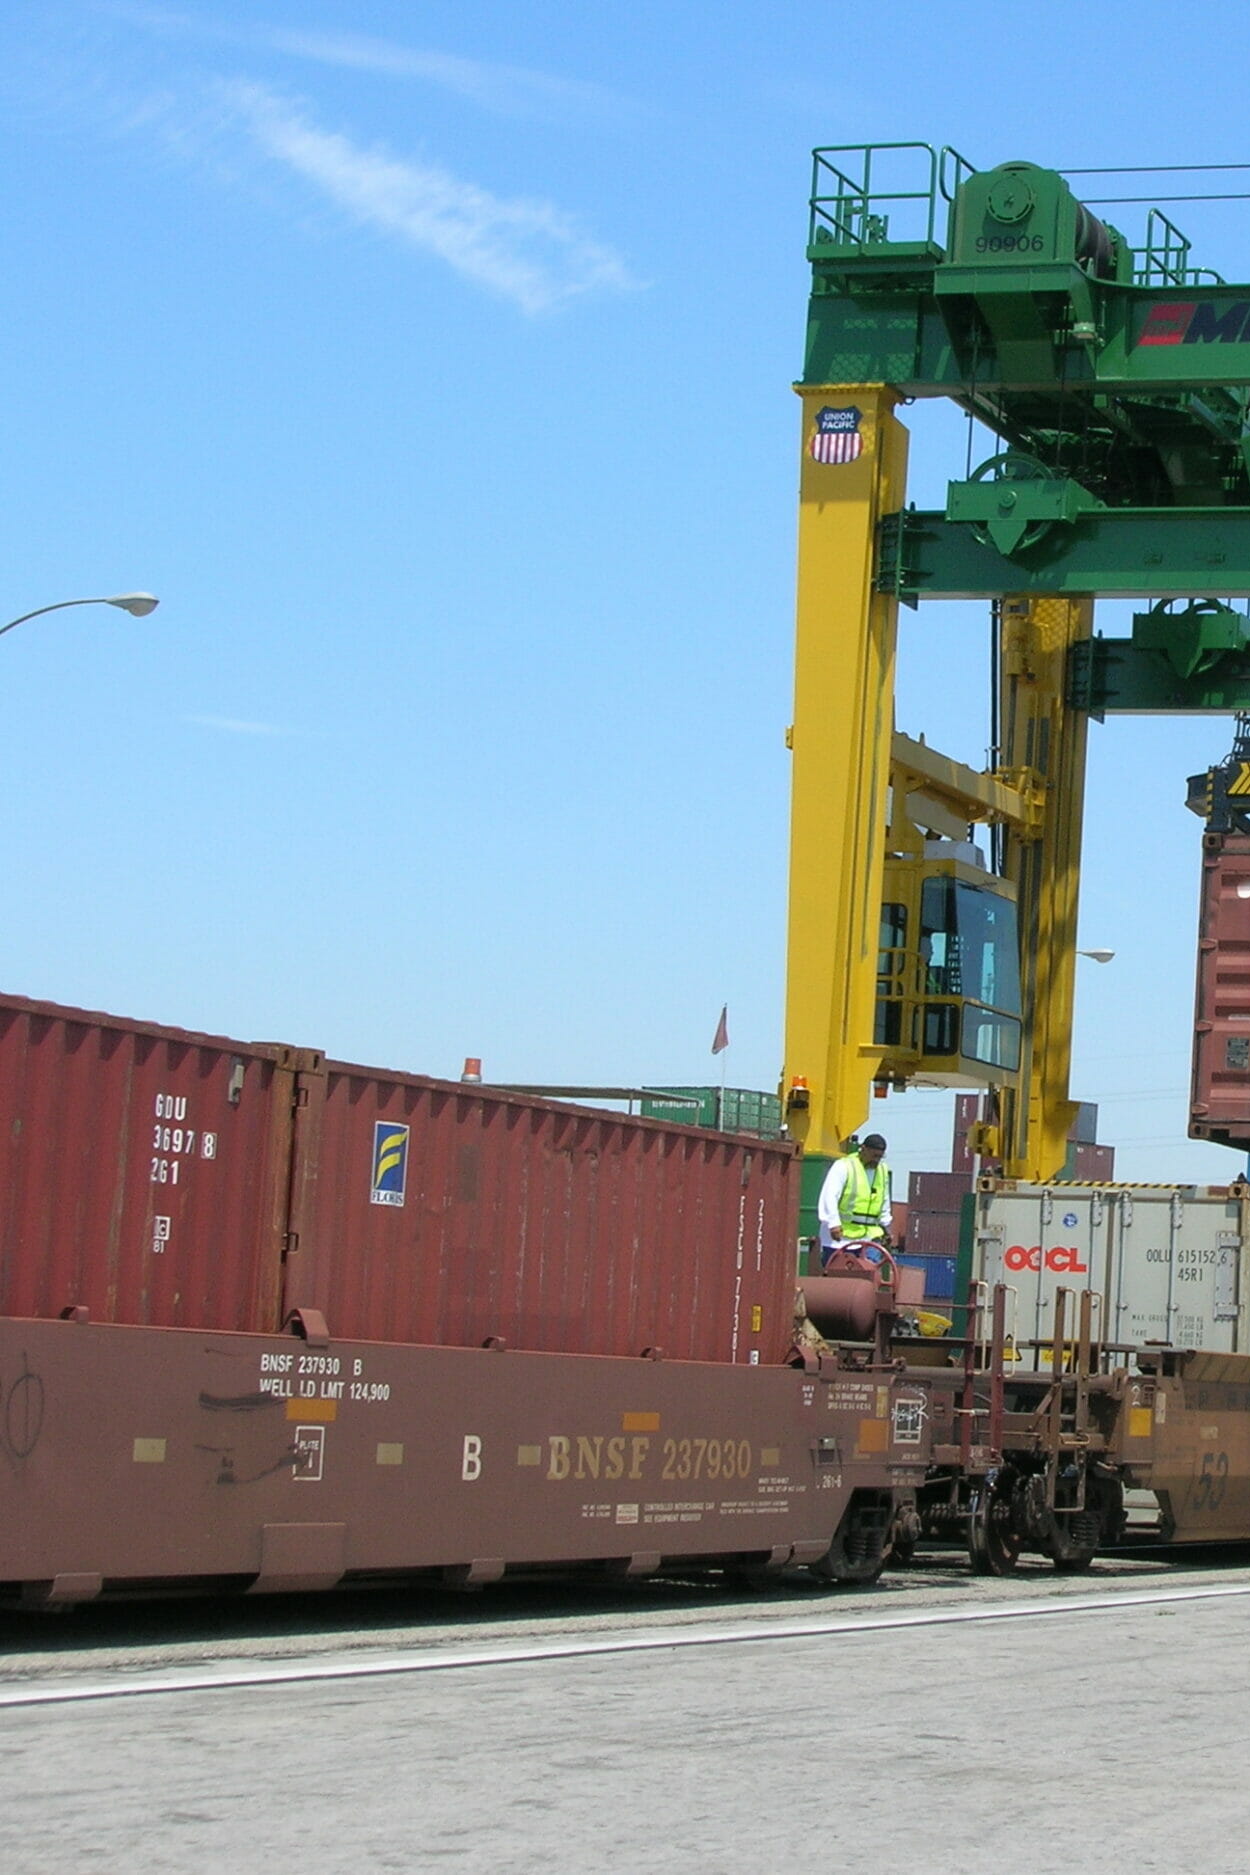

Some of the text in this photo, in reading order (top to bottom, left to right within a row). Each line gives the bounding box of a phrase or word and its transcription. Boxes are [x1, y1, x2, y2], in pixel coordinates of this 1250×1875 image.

[975, 235, 1044, 253] 90906
[822, 420, 855, 430] PACIFIC
[824, 412, 854, 421] UNION
[1004, 1245, 1087, 1274] OOCL
[1146, 1249, 1228, 1265] OOLU 615152 6
[1177, 1267, 1204, 1281] 45R1
[260, 1353, 363, 1377] BNSF 237930 B
[259, 1378, 391, 1403] WELL LD LMT 124,900
[461, 1434, 751, 1481] B BNSF 237930
